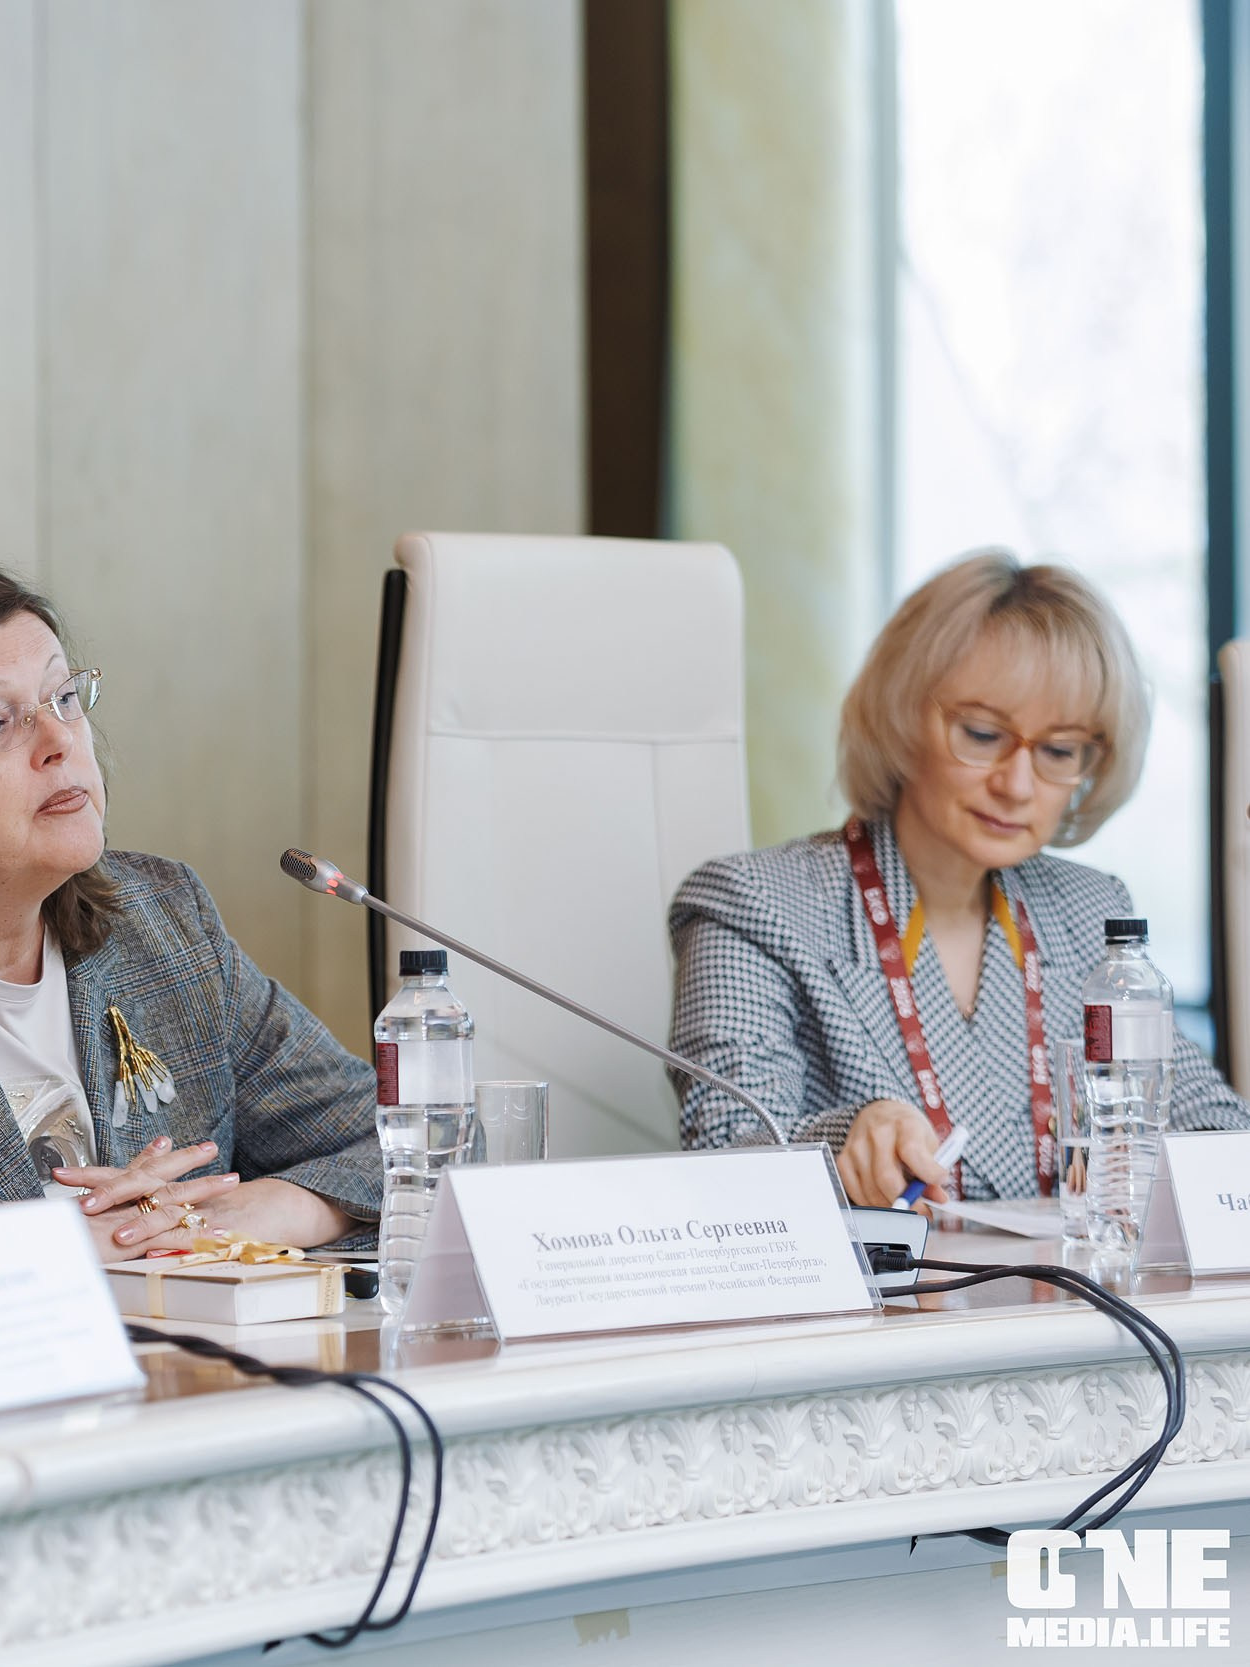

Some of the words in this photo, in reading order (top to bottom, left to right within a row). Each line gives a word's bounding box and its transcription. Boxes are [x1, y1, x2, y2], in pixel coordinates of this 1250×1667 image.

[890, 976, 913, 1018] 2026
[531, 1231, 614, 1253] Хомова
[617, 1224, 682, 1245] Ольга
[686, 1219, 788, 1243] Сергеевна
[535, 1255, 606, 1272] Генеральный
[609, 1253, 655, 1267] директор
[656, 1245, 767, 1261] Санкт-Петербургского
[769, 1240, 798, 1254] ГБУК
[614, 1267, 687, 1281] академическая
[690, 1263, 729, 1276] капелла
[535, 1293, 576, 1308] Лауреат
[578, 1285, 667, 1303] Государственной
[669, 1282, 707, 1296] премии
[709, 1277, 766, 1290] Российской
[768, 1274, 821, 1287] Федерации
